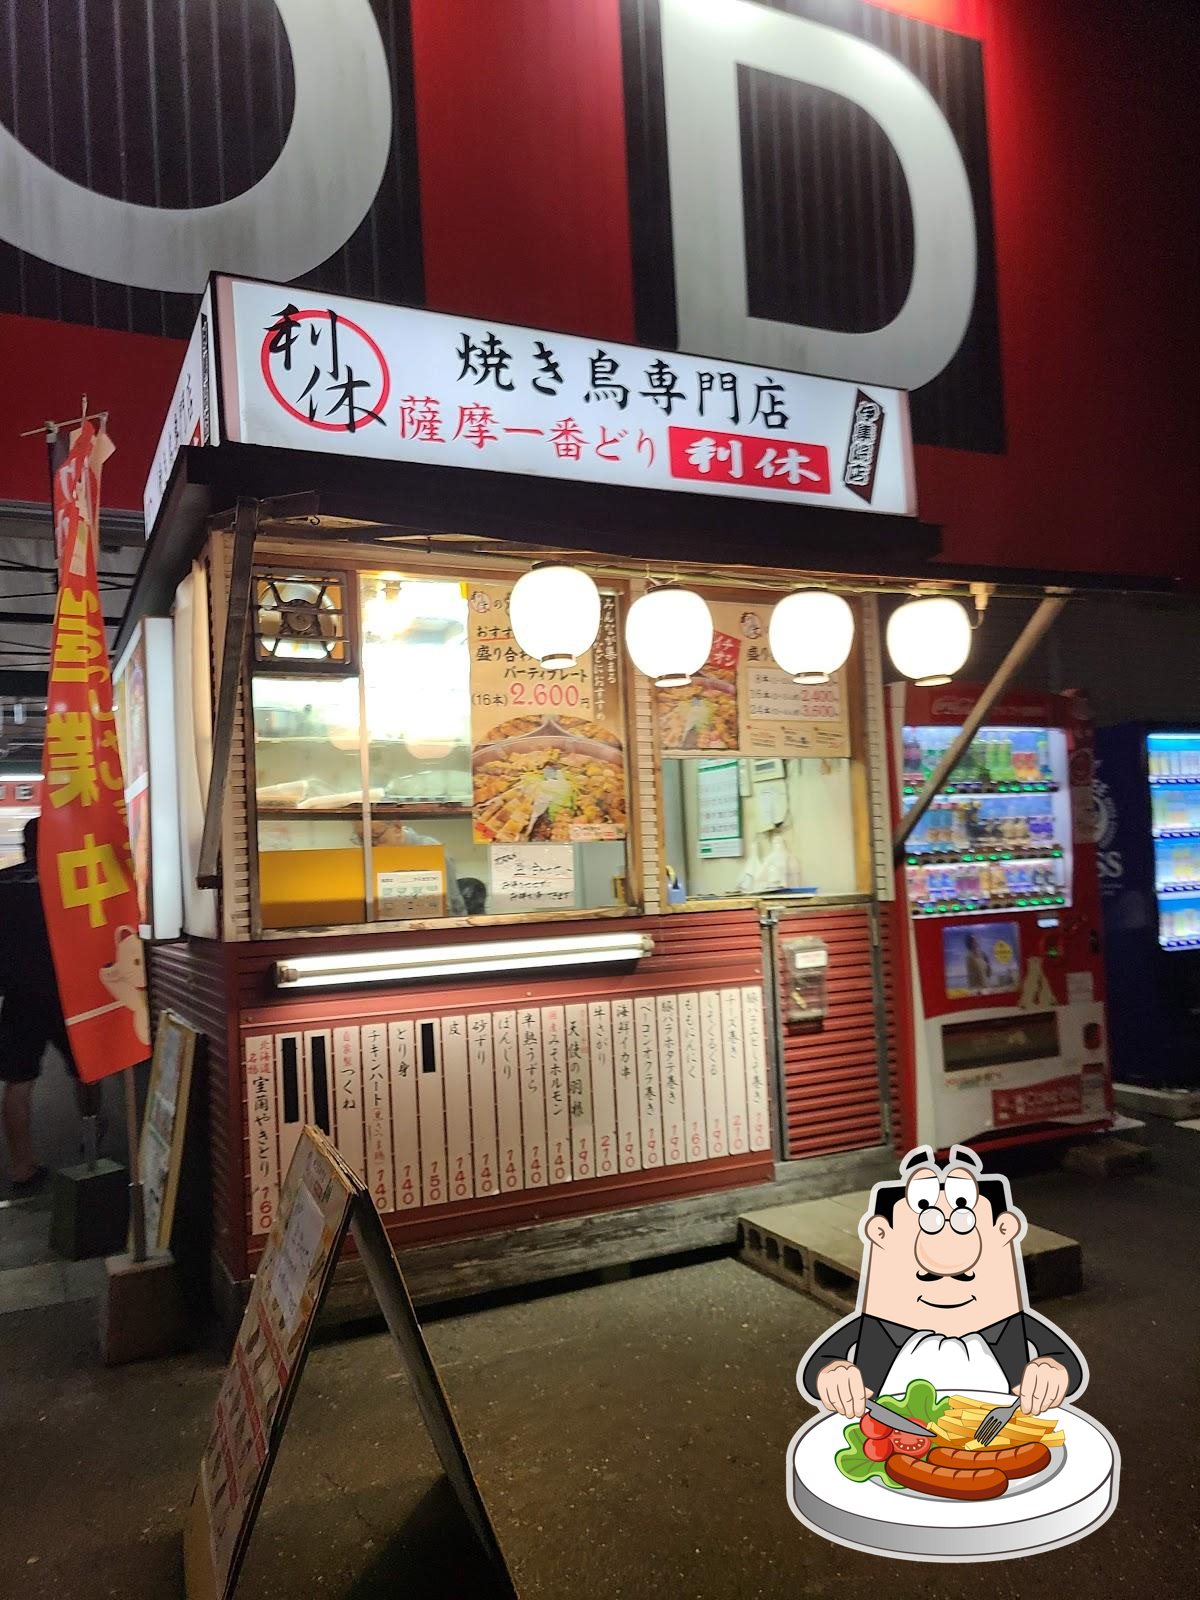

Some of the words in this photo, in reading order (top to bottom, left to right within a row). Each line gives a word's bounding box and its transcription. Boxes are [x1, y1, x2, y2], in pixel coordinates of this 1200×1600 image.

[263, 302, 386, 433] 利休
[456, 331, 791, 430] 焼き鳥専門店
[399, 394, 655, 467] 薩摩一番どり
[684, 436, 823, 484] 利休
[647, 1128, 658, 1164] 190
[670, 1124, 681, 1160] 190
[691, 1121, 702, 1157] 160
[712, 1118, 723, 1153] 190
[732, 1115, 743, 1150] 210
[752, 1112, 765, 1147] 190
[505, 1149, 517, 1188] 140
[530, 1146, 542, 1184] 140
[554, 1142, 565, 1180] 140
[579, 1138, 590, 1176] 190
[600, 1135, 612, 1172] 210
[625, 1132, 636, 1168] 190
[375, 1169, 387, 1210] 140
[402, 1164, 414, 1205] 140
[429, 1161, 441, 1201] 150
[455, 1156, 466, 1196] 140
[481, 1153, 493, 1192] 140
[259, 1187, 272, 1229] 160
